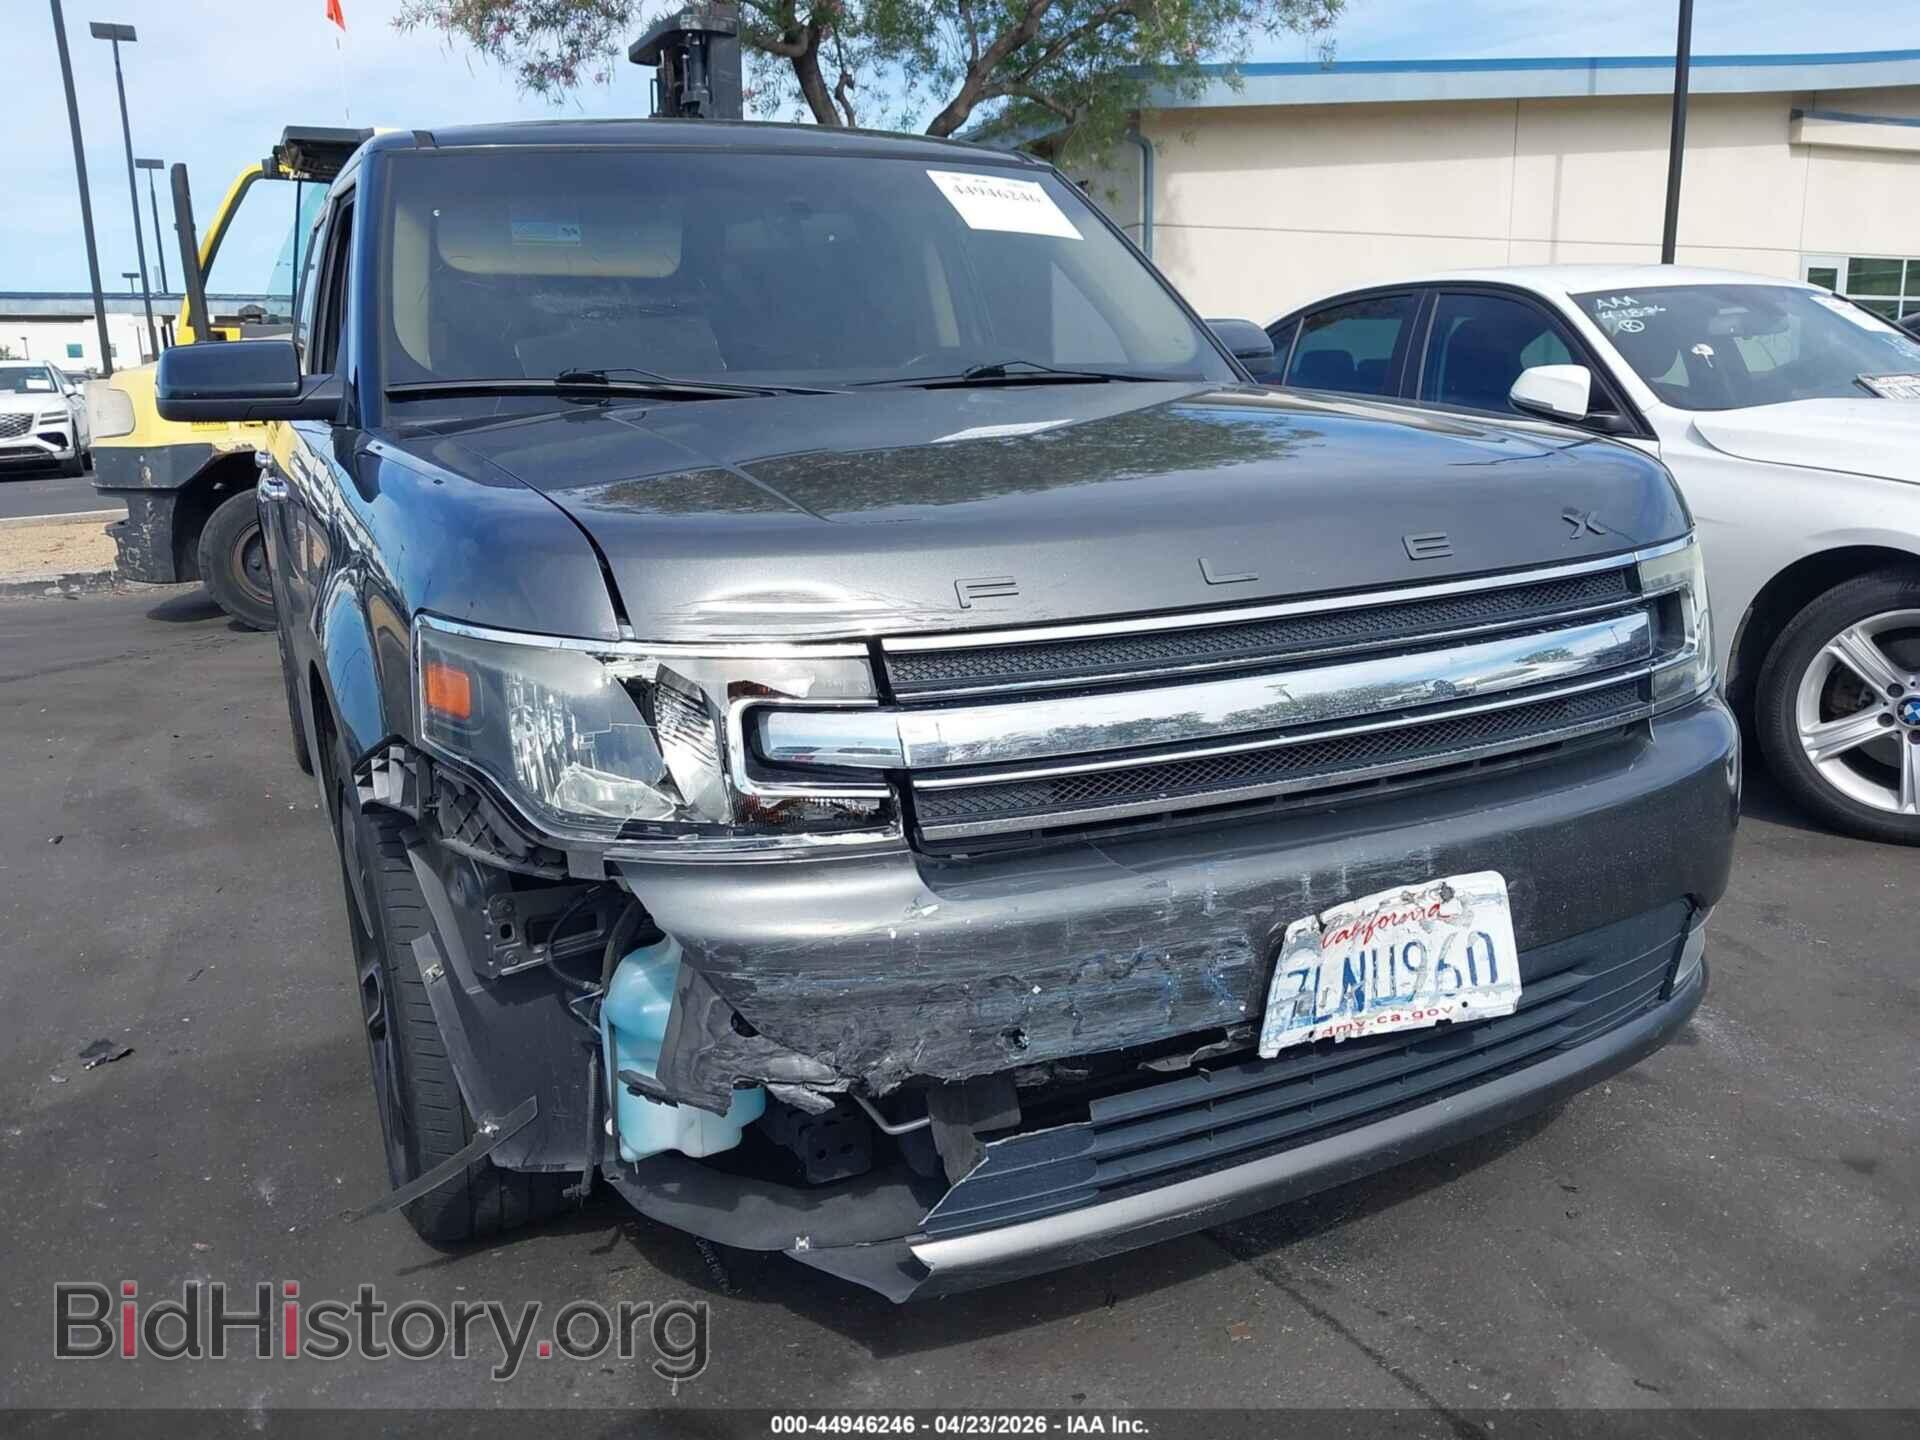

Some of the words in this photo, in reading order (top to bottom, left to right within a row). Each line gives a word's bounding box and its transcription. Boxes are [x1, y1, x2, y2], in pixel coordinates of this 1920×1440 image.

[954, 507, 1607, 610] FLEX
[1322, 902, 1451, 950] California
[1321, 1005, 1454, 1038] dmv.ca.gov
